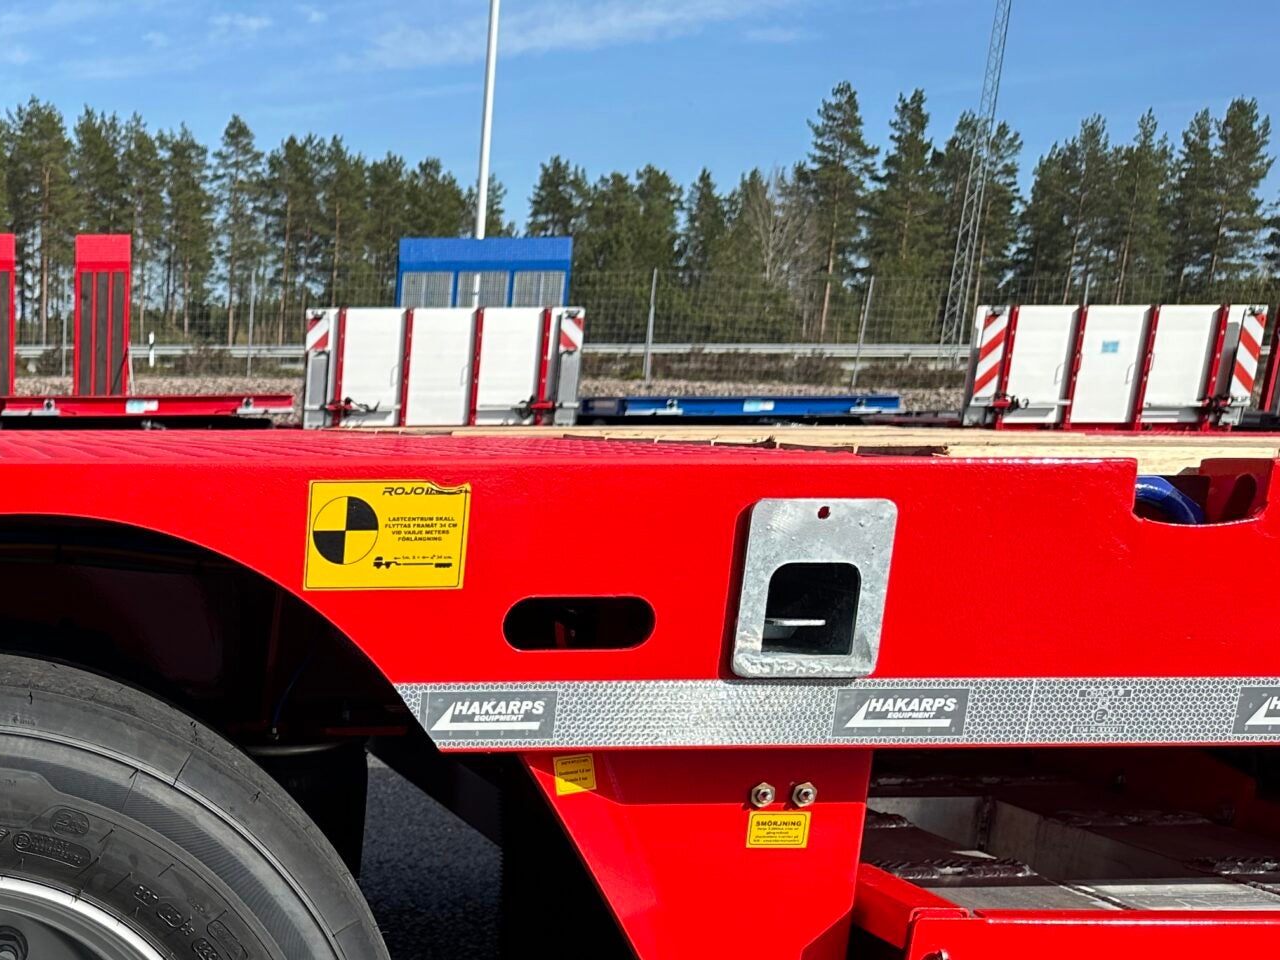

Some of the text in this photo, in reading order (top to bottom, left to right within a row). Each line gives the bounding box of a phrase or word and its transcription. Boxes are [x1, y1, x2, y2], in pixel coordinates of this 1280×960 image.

[382, 486, 426, 496] ROJO
[454, 700, 545, 715] HAKARPS
[868, 698, 957, 712] HAKARPS
[474, 714, 524, 722] EQUIPMENT
[887, 711, 935, 719] EQUIPMENT
